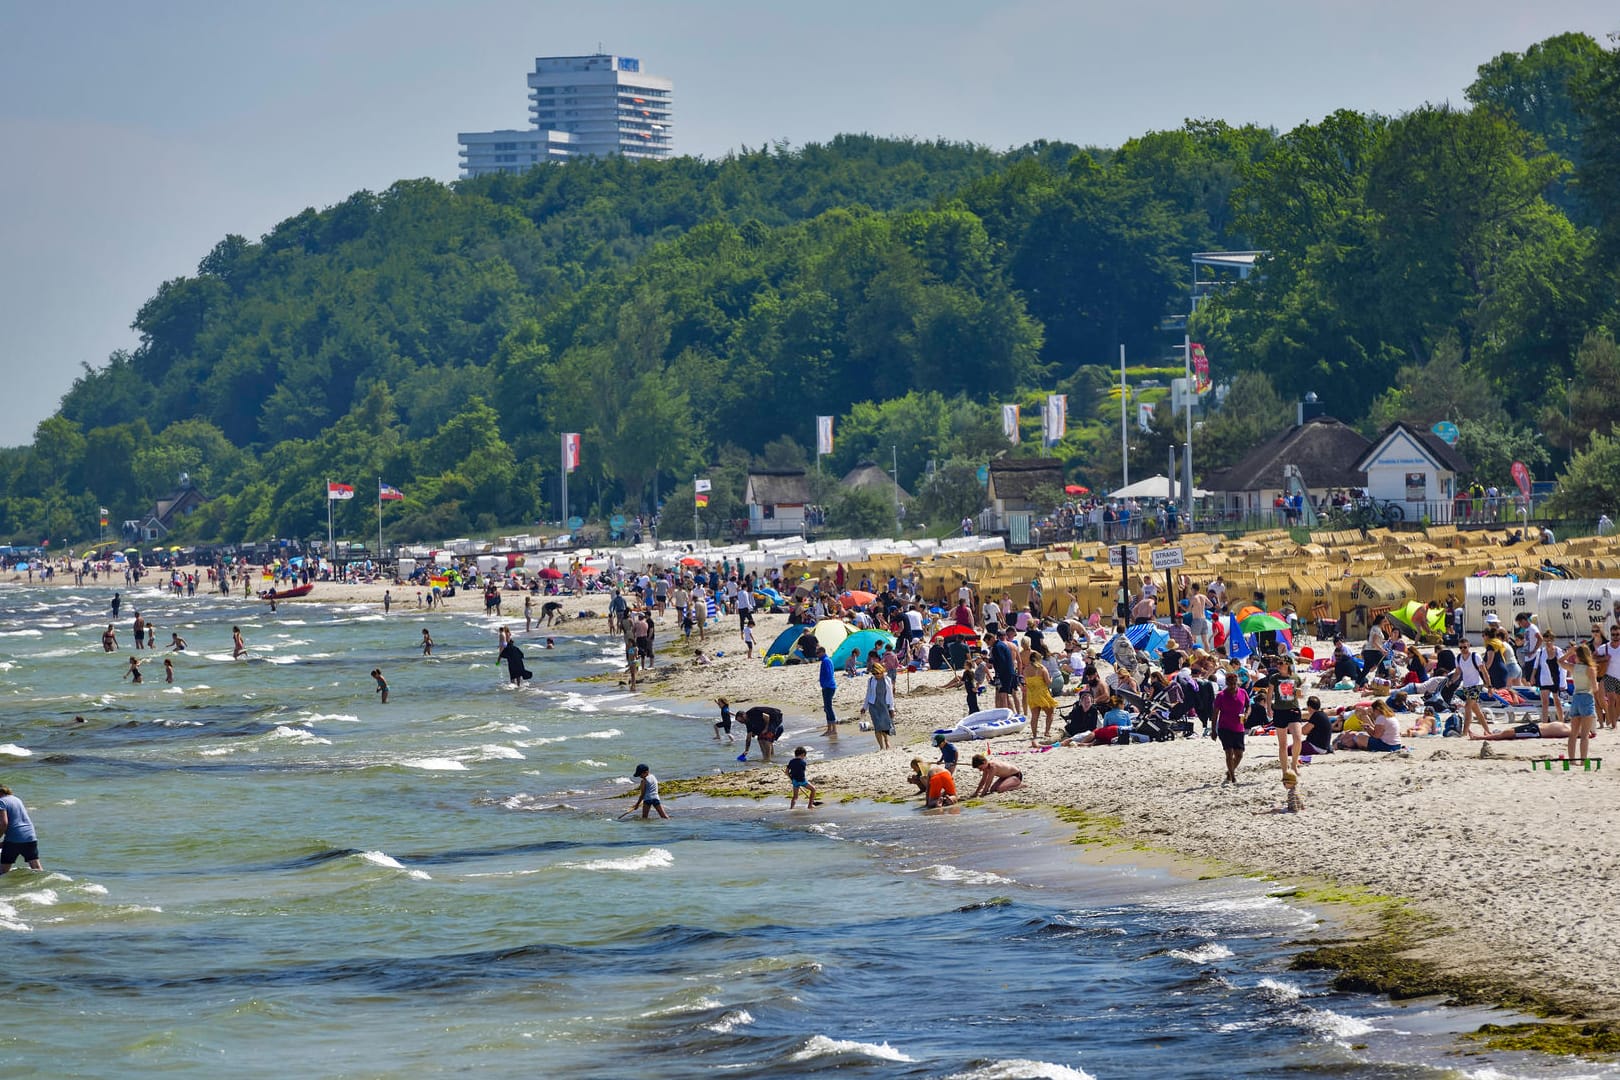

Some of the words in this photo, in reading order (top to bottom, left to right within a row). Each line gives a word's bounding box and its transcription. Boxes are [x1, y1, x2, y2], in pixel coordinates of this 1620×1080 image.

[1155, 551, 1178, 559] STRAND-
[1155, 558, 1181, 566] MUSCHEL
[1481, 595, 1496, 607] 88
[1561, 598, 1572, 610] 6
[1587, 599, 1602, 612] 26
[1562, 612, 1573, 620] M
